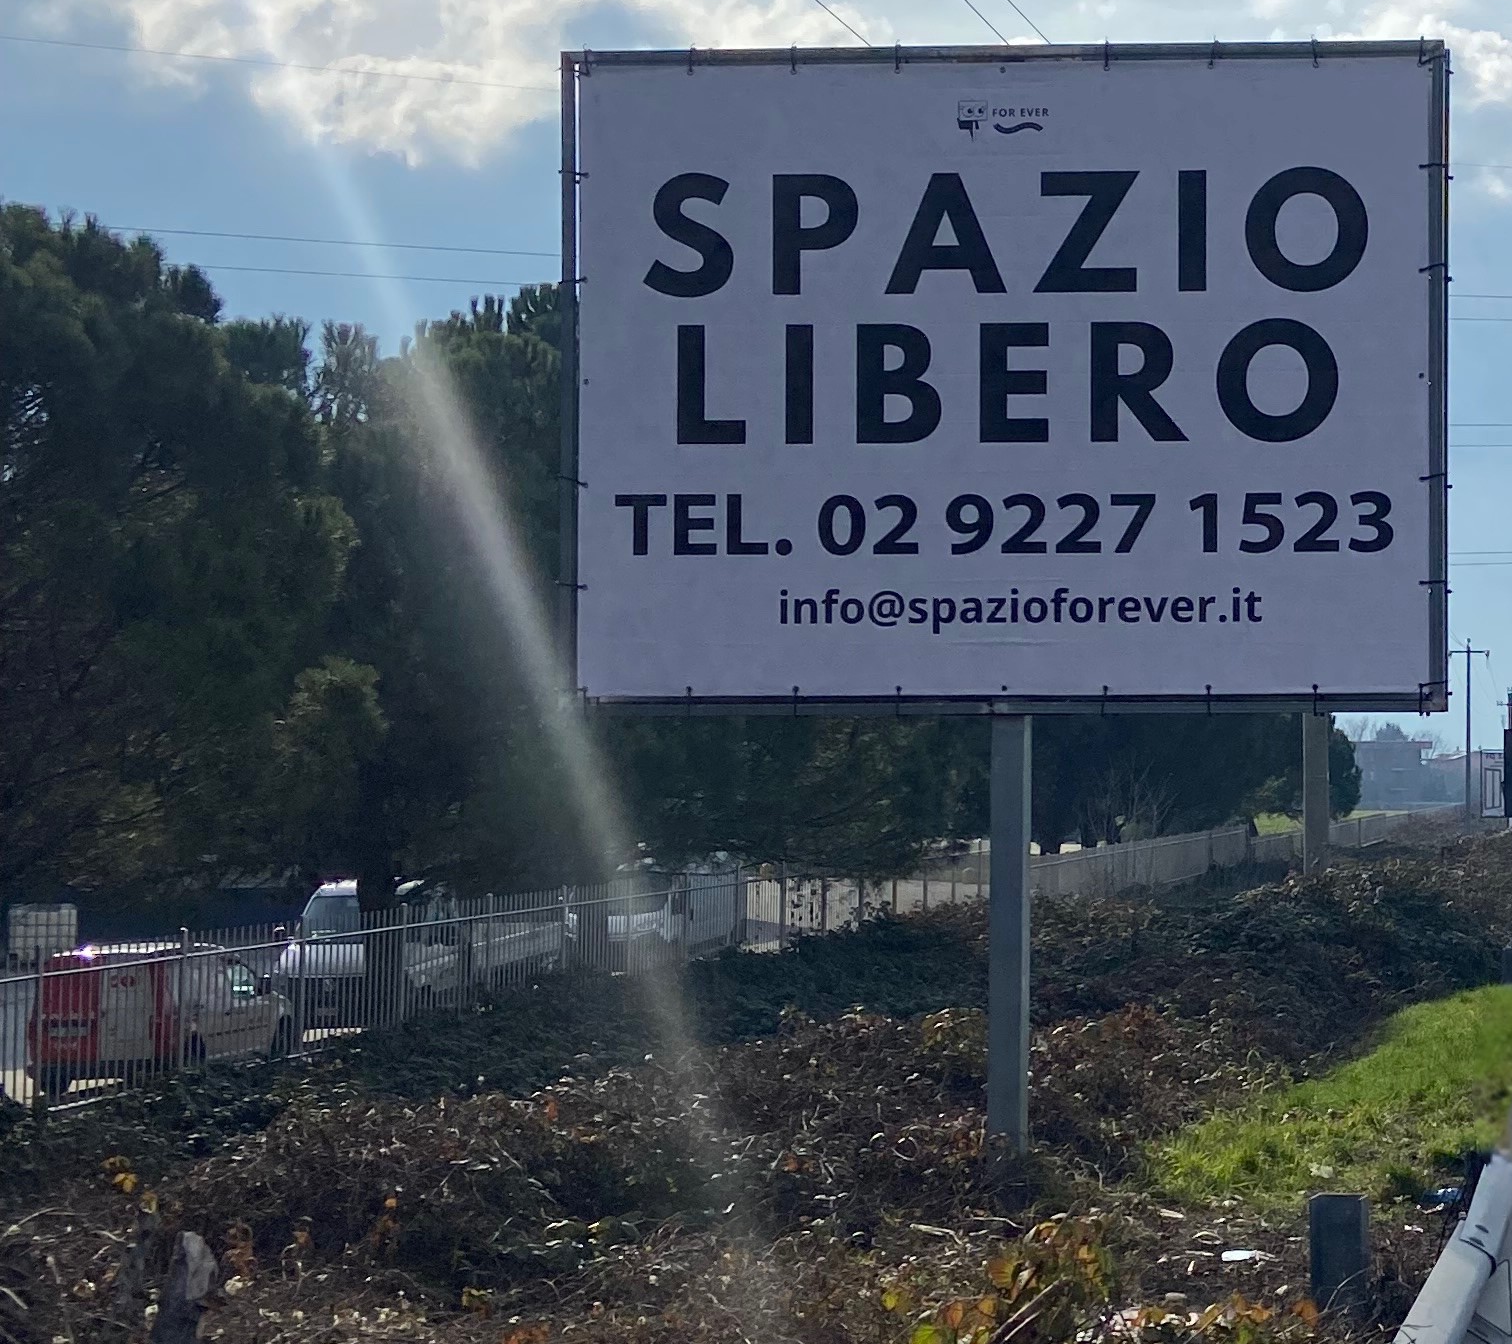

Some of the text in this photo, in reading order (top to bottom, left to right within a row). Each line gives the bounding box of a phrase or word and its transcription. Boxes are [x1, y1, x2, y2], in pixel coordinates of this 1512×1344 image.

[992, 107, 1050, 118] FOR EVER
[643, 166, 1368, 298] SPAZIO
[676, 317, 1339, 445] LIBERO
[615, 491, 1394, 556] TEL. 02 9227 1523
[779, 587, 1263, 634] info@spazioforever.it
